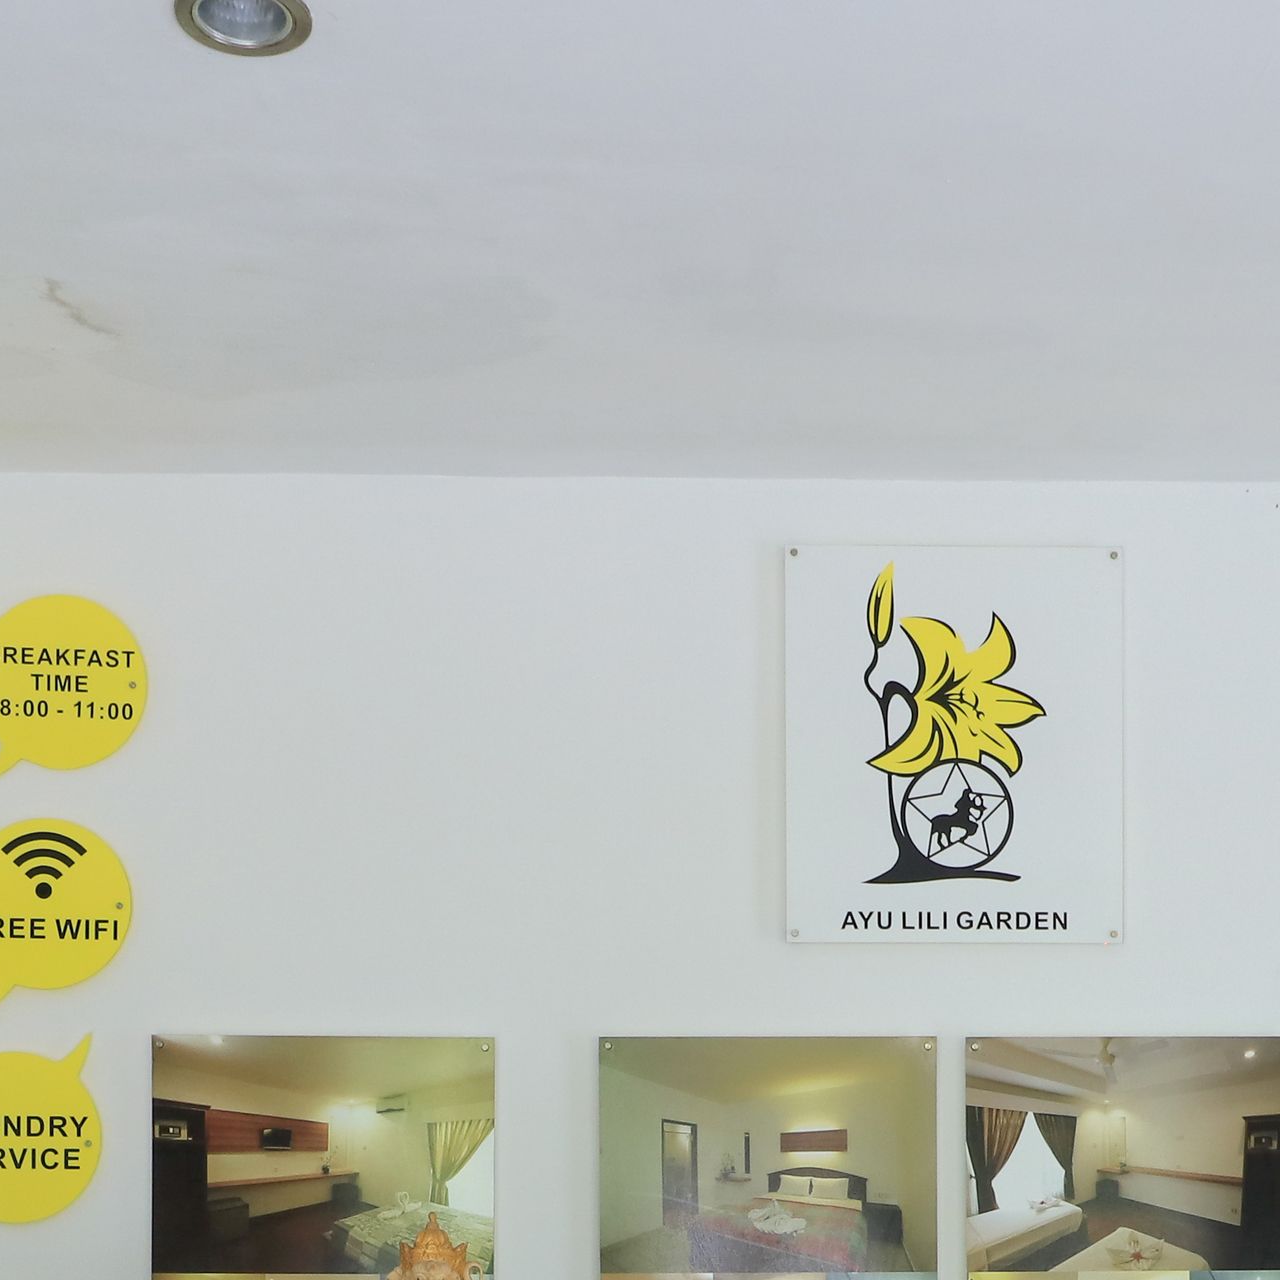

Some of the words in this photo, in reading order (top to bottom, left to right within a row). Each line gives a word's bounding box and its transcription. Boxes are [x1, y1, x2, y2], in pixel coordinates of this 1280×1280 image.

[30, 673, 88, 693] TIME
[74, 700, 133, 720] 11:00
[55, 918, 118, 941] WIFI
[841, 911, 892, 930] AYU
[902, 911, 947, 930] LILI
[956, 911, 1067, 930] GARDEN
